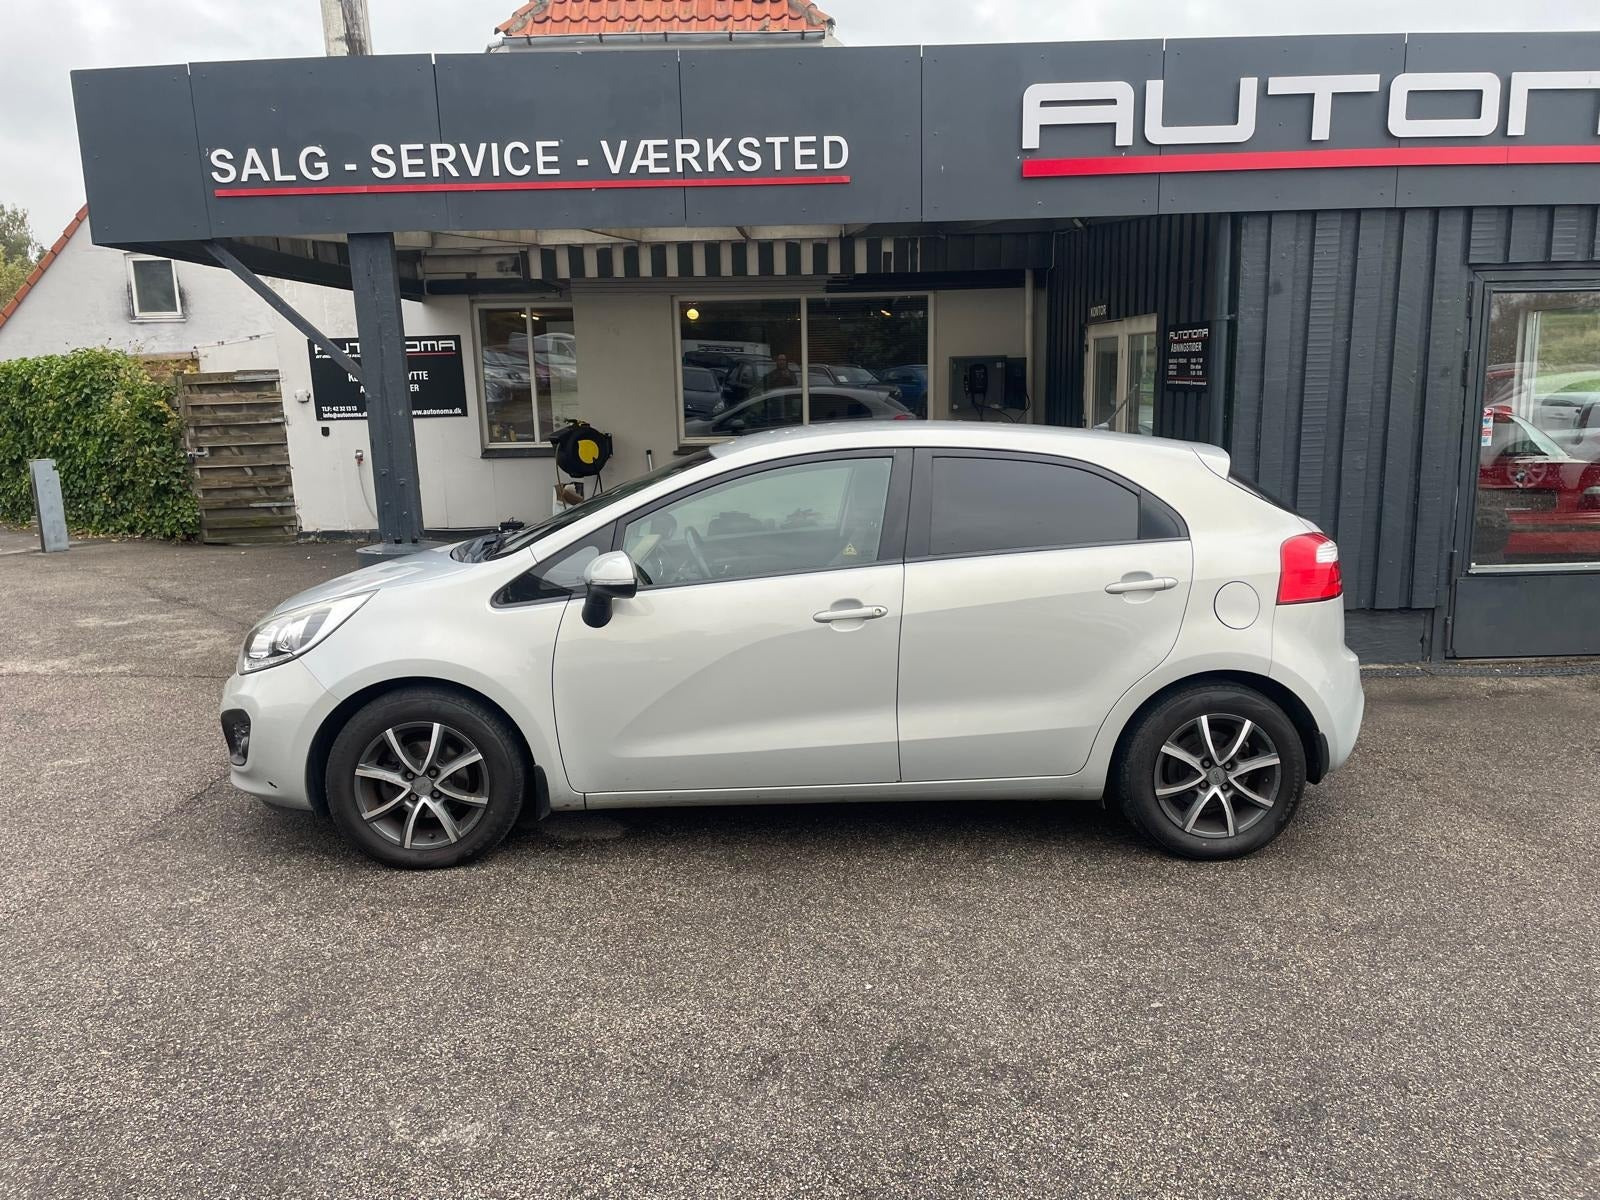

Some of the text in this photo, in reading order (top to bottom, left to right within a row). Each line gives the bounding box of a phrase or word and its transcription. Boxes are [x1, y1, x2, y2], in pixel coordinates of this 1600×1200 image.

[210, 135, 849, 183] SALG - SERVICE - VÆRKSTED
[1169, 328, 1209, 340] AUTONOMA
